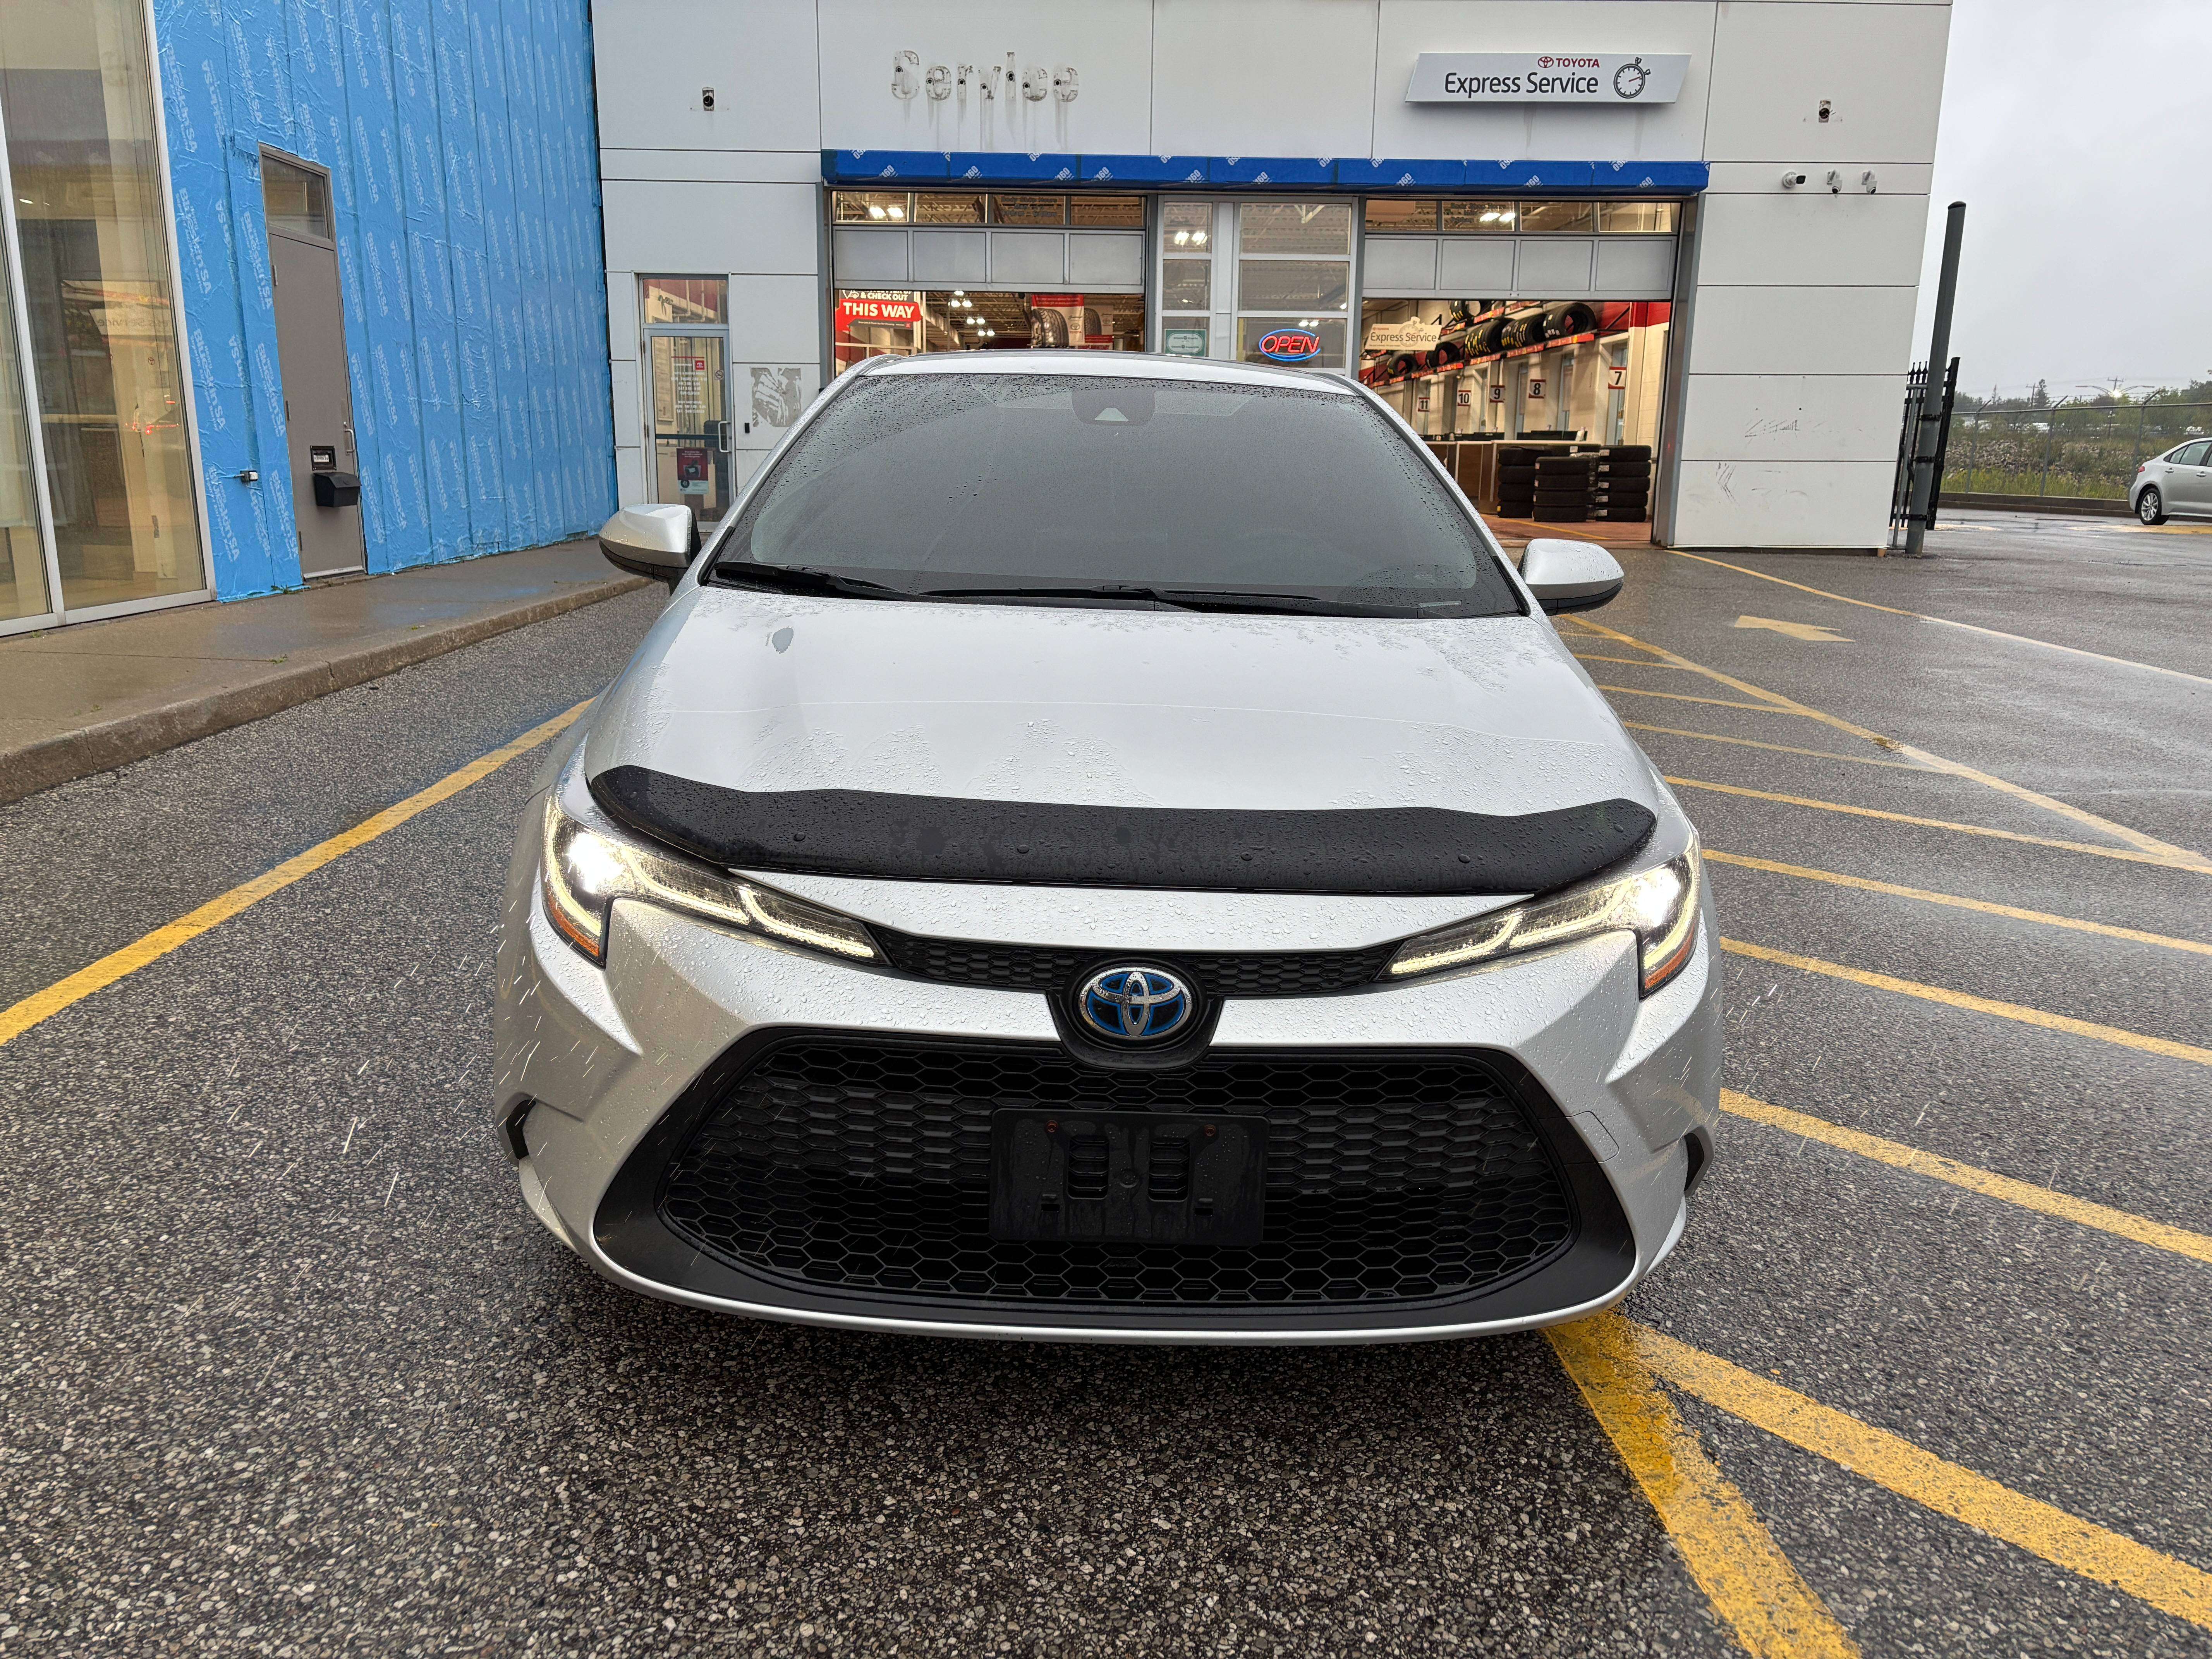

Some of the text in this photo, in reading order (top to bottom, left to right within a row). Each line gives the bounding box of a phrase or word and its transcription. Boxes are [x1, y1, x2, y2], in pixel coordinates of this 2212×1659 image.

[1556, 58, 1600, 68] TOYOTA
[891, 50, 1079, 103] Service
[1445, 72, 1599, 99] Express Service
[215, 199, 226, 224] SA
[179, 187, 211, 294] Blueskin SA
[843, 302, 915, 318] THIS WAY
[1262, 336, 1320, 354] OPEN
[1370, 332, 1437, 343] Express Service
[229, 334, 239, 359] SA
[194, 329, 226, 426] Blueskin SA
[1614, 371, 1622, 385] 7
[1494, 389, 1501, 399] 9
[1533, 383, 1540, 396] 8
[1420, 400, 1428, 409] 11
[1459, 393, 1470, 404] 10
[276, 413, 286, 436] SA
